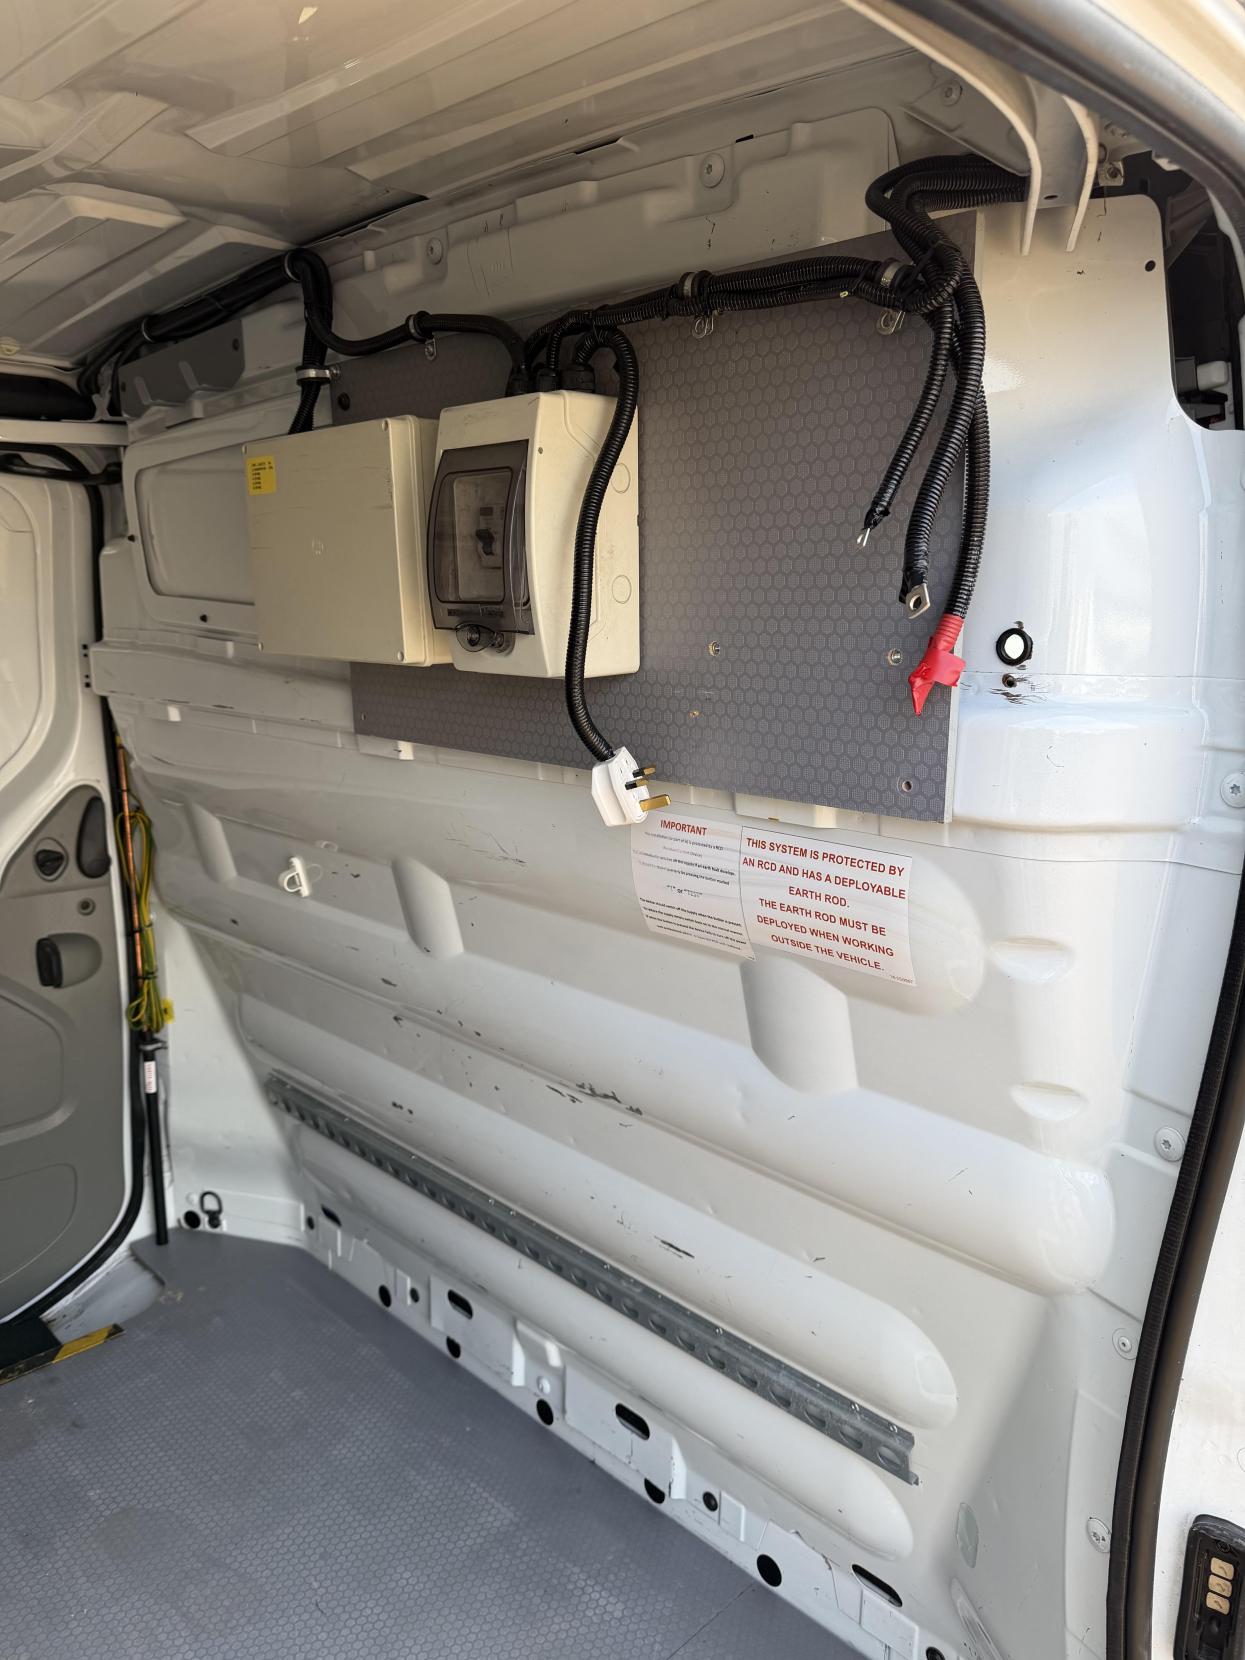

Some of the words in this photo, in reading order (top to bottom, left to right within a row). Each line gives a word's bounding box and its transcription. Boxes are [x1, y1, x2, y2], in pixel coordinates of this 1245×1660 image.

[660, 820, 707, 836] IMPORTANT
[747, 838, 766, 849] THIS
[769, 842, 807, 858] SYSTEM
[810, 850, 819, 859] IS
[822, 852, 885, 872] PROTECTED
[889, 866, 904, 876] BY
[742, 857, 754, 867] AN
[758, 861, 776, 872] RCD
[779, 865, 799, 876] AND
[802, 869, 822, 881] HAS
[825, 874, 831, 883] A
[835, 876, 905, 899] DEPLOYABLE
[789, 887, 821, 900] EARTH
[825, 894, 850, 908] ROD.
[757, 915, 807, 933] DEPLOYED
[809, 928, 839, 942] WHEN
[842, 937, 894, 956] WORKING
[759, 899, 777, 909] THE
[780, 902, 811, 918] EARTH
[815, 912, 836, 923] ROD
[839, 917, 868, 931] MUST
[872, 925, 886, 936] BE
[771, 935, 812, 951] OUTSIDE
[814, 945, 834, 956] THE
[837, 951, 884, 971] VEHICLE.
